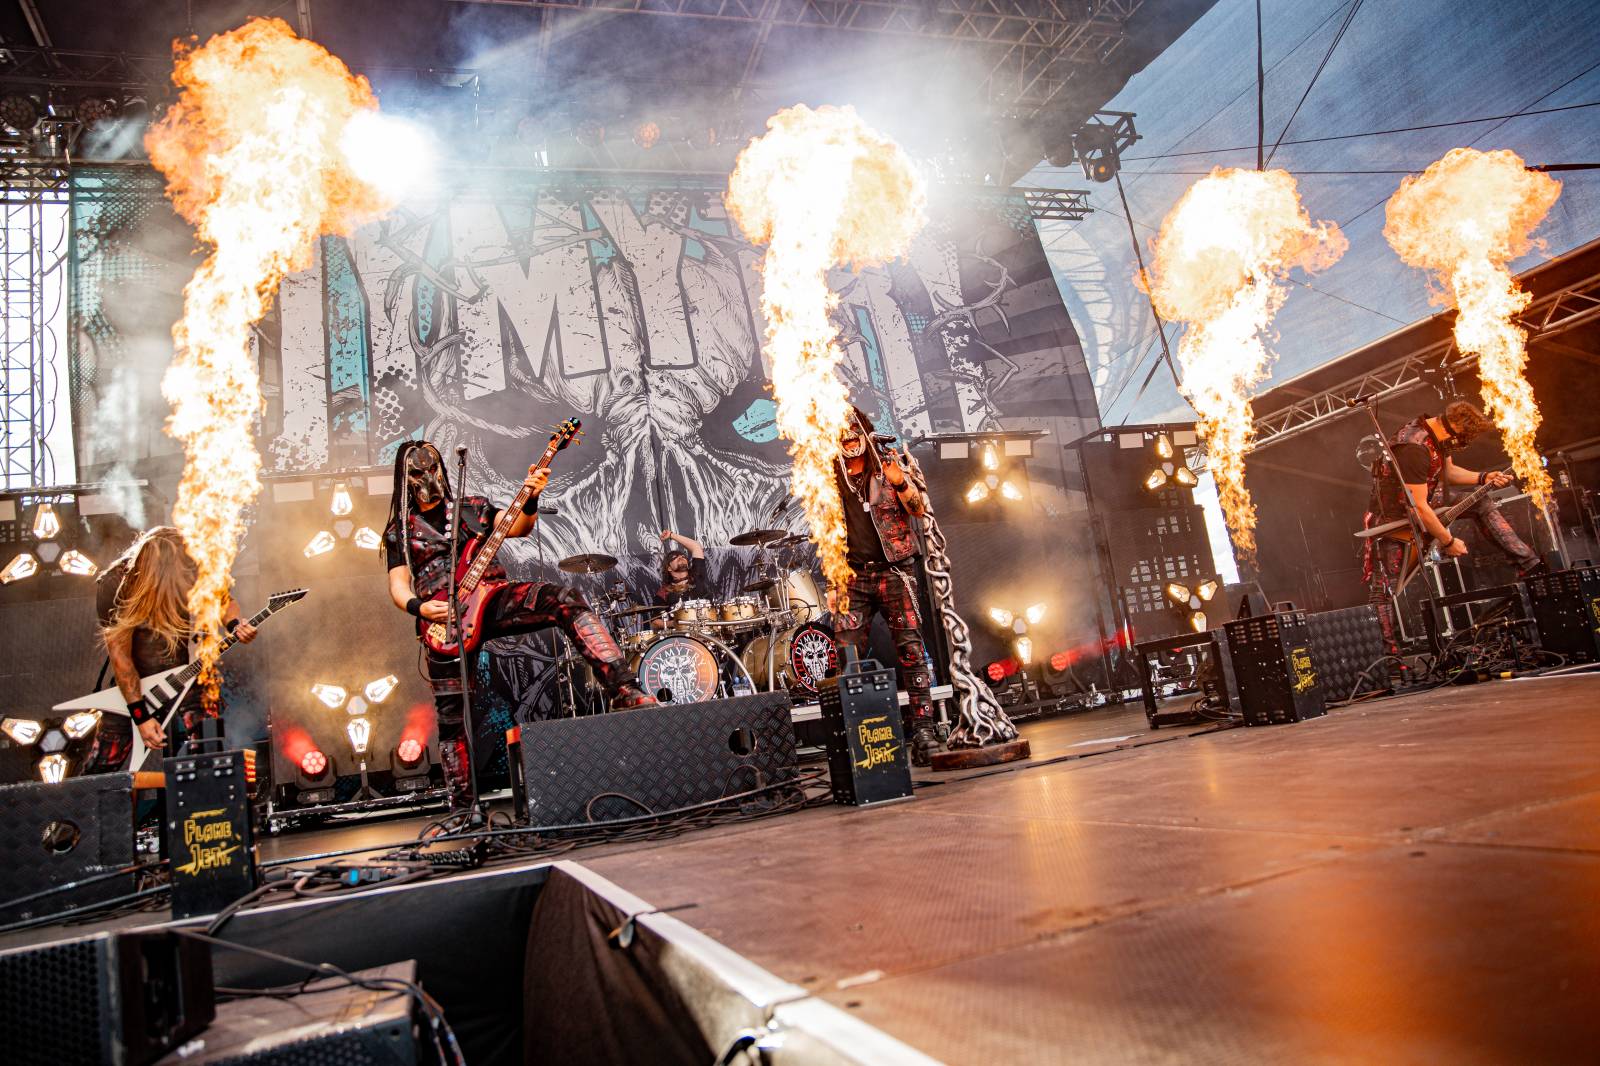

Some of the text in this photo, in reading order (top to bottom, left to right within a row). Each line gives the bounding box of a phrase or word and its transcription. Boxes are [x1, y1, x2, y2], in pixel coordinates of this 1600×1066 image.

[795, 633, 834, 656] DYMYTRY
[650, 647, 707, 672] DYMYTRY
[858, 724, 894, 746] FLAME
[183, 819, 232, 846] FLAME
